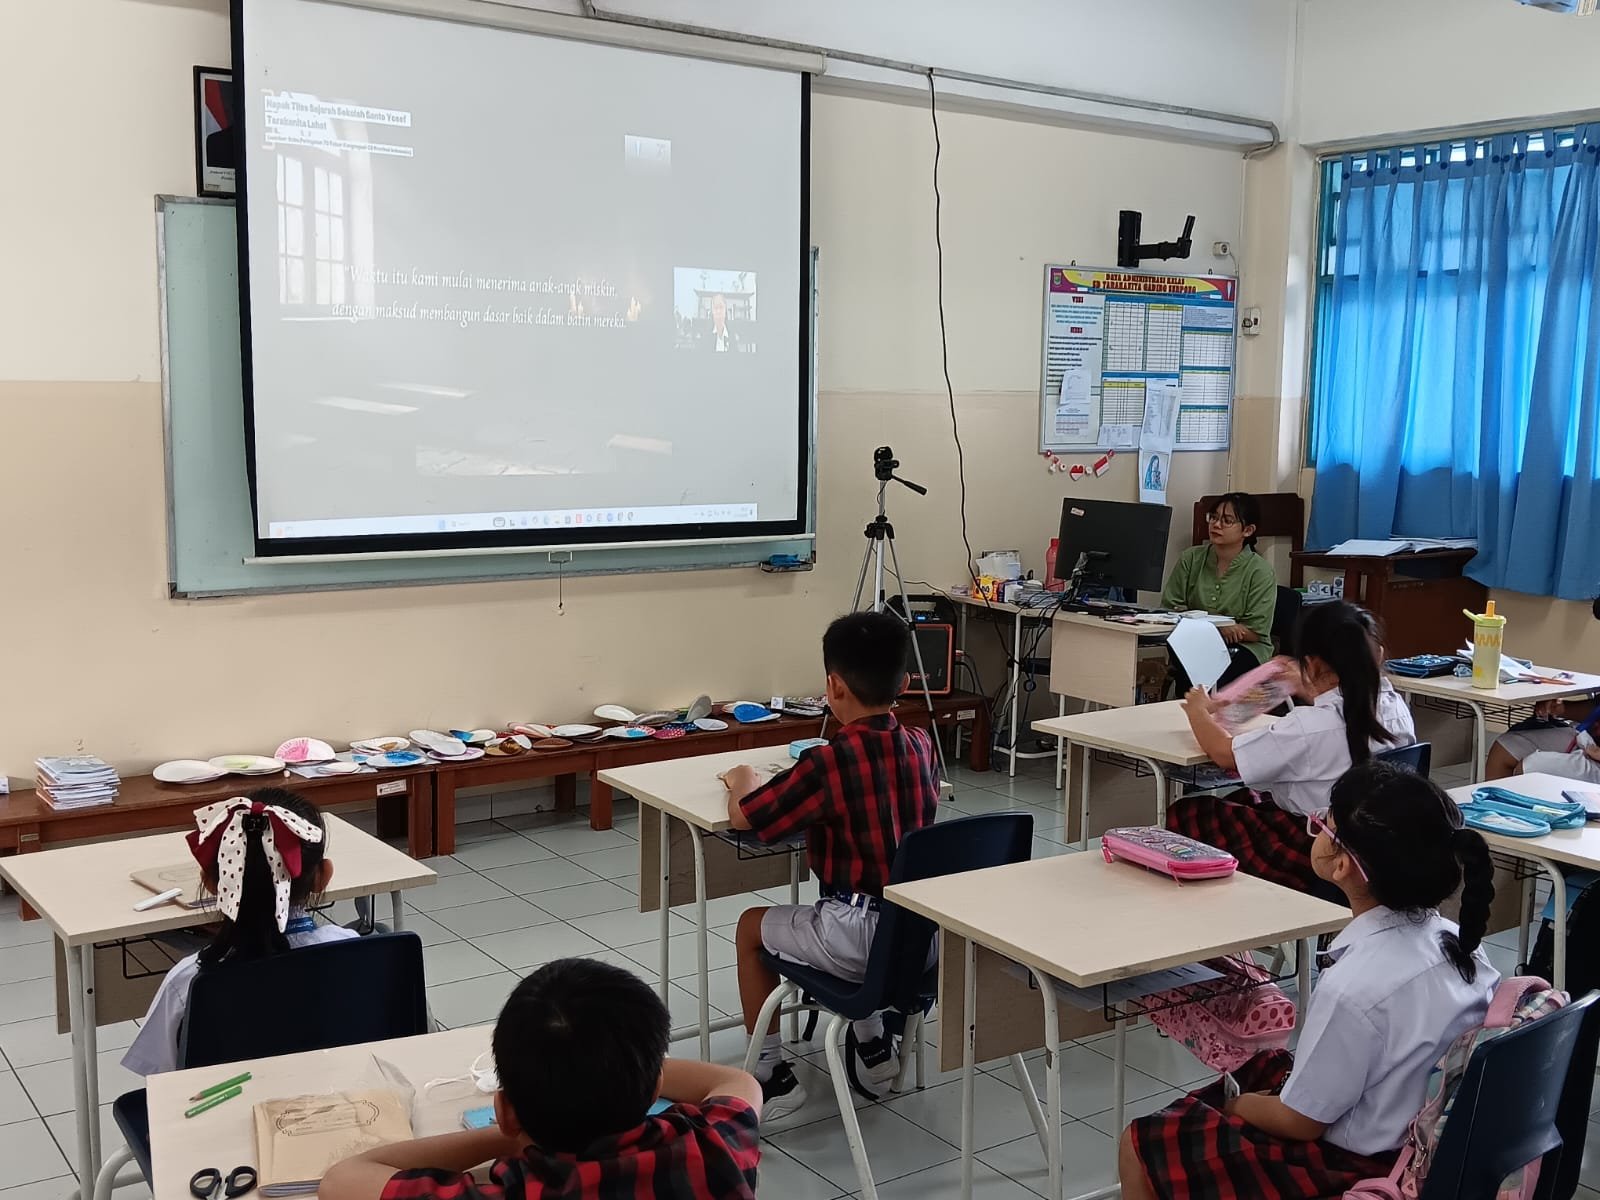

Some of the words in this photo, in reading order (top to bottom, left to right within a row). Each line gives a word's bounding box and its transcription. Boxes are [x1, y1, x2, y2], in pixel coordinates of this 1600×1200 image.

[391, 268, 407, 285] itu
[411, 267, 438, 287] kami
[442, 270, 472, 289] mulai
[476, 274, 526, 292] menerima
[529, 275, 582, 296] anak-anak
[375, 301, 416, 320] maksud
[420, 303, 480, 327] membangun
[483, 303, 509, 323] dasar
[512, 304, 533, 324] baik
[535, 306, 564, 326] dalam
[567, 309, 591, 328] batin
